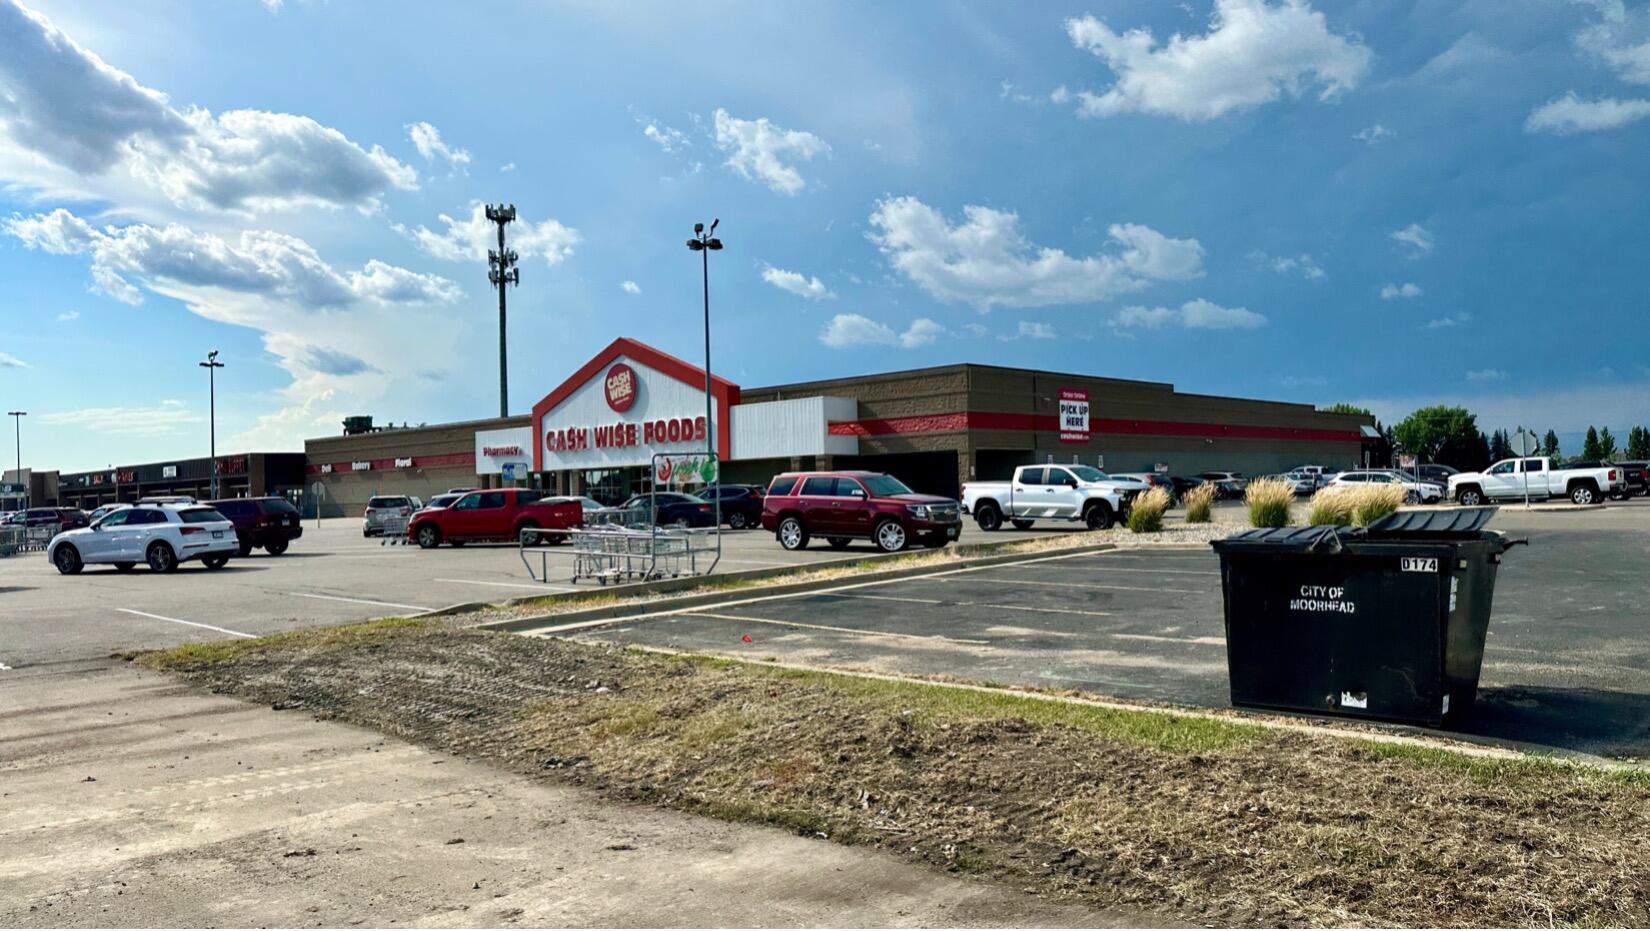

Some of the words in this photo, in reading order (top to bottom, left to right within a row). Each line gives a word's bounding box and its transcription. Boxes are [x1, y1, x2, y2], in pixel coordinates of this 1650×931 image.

[1061, 404, 1077, 415] PICK
[1079, 405, 1088, 415] UP
[1066, 416, 1084, 427] HERE
[643, 416, 706, 445] FOODS
[1402, 558, 1437, 571] D174
[1300, 585, 1327, 597] CITY
[1328, 586, 1344, 599] OF
[1290, 599, 1355, 614] MOORHEAD
